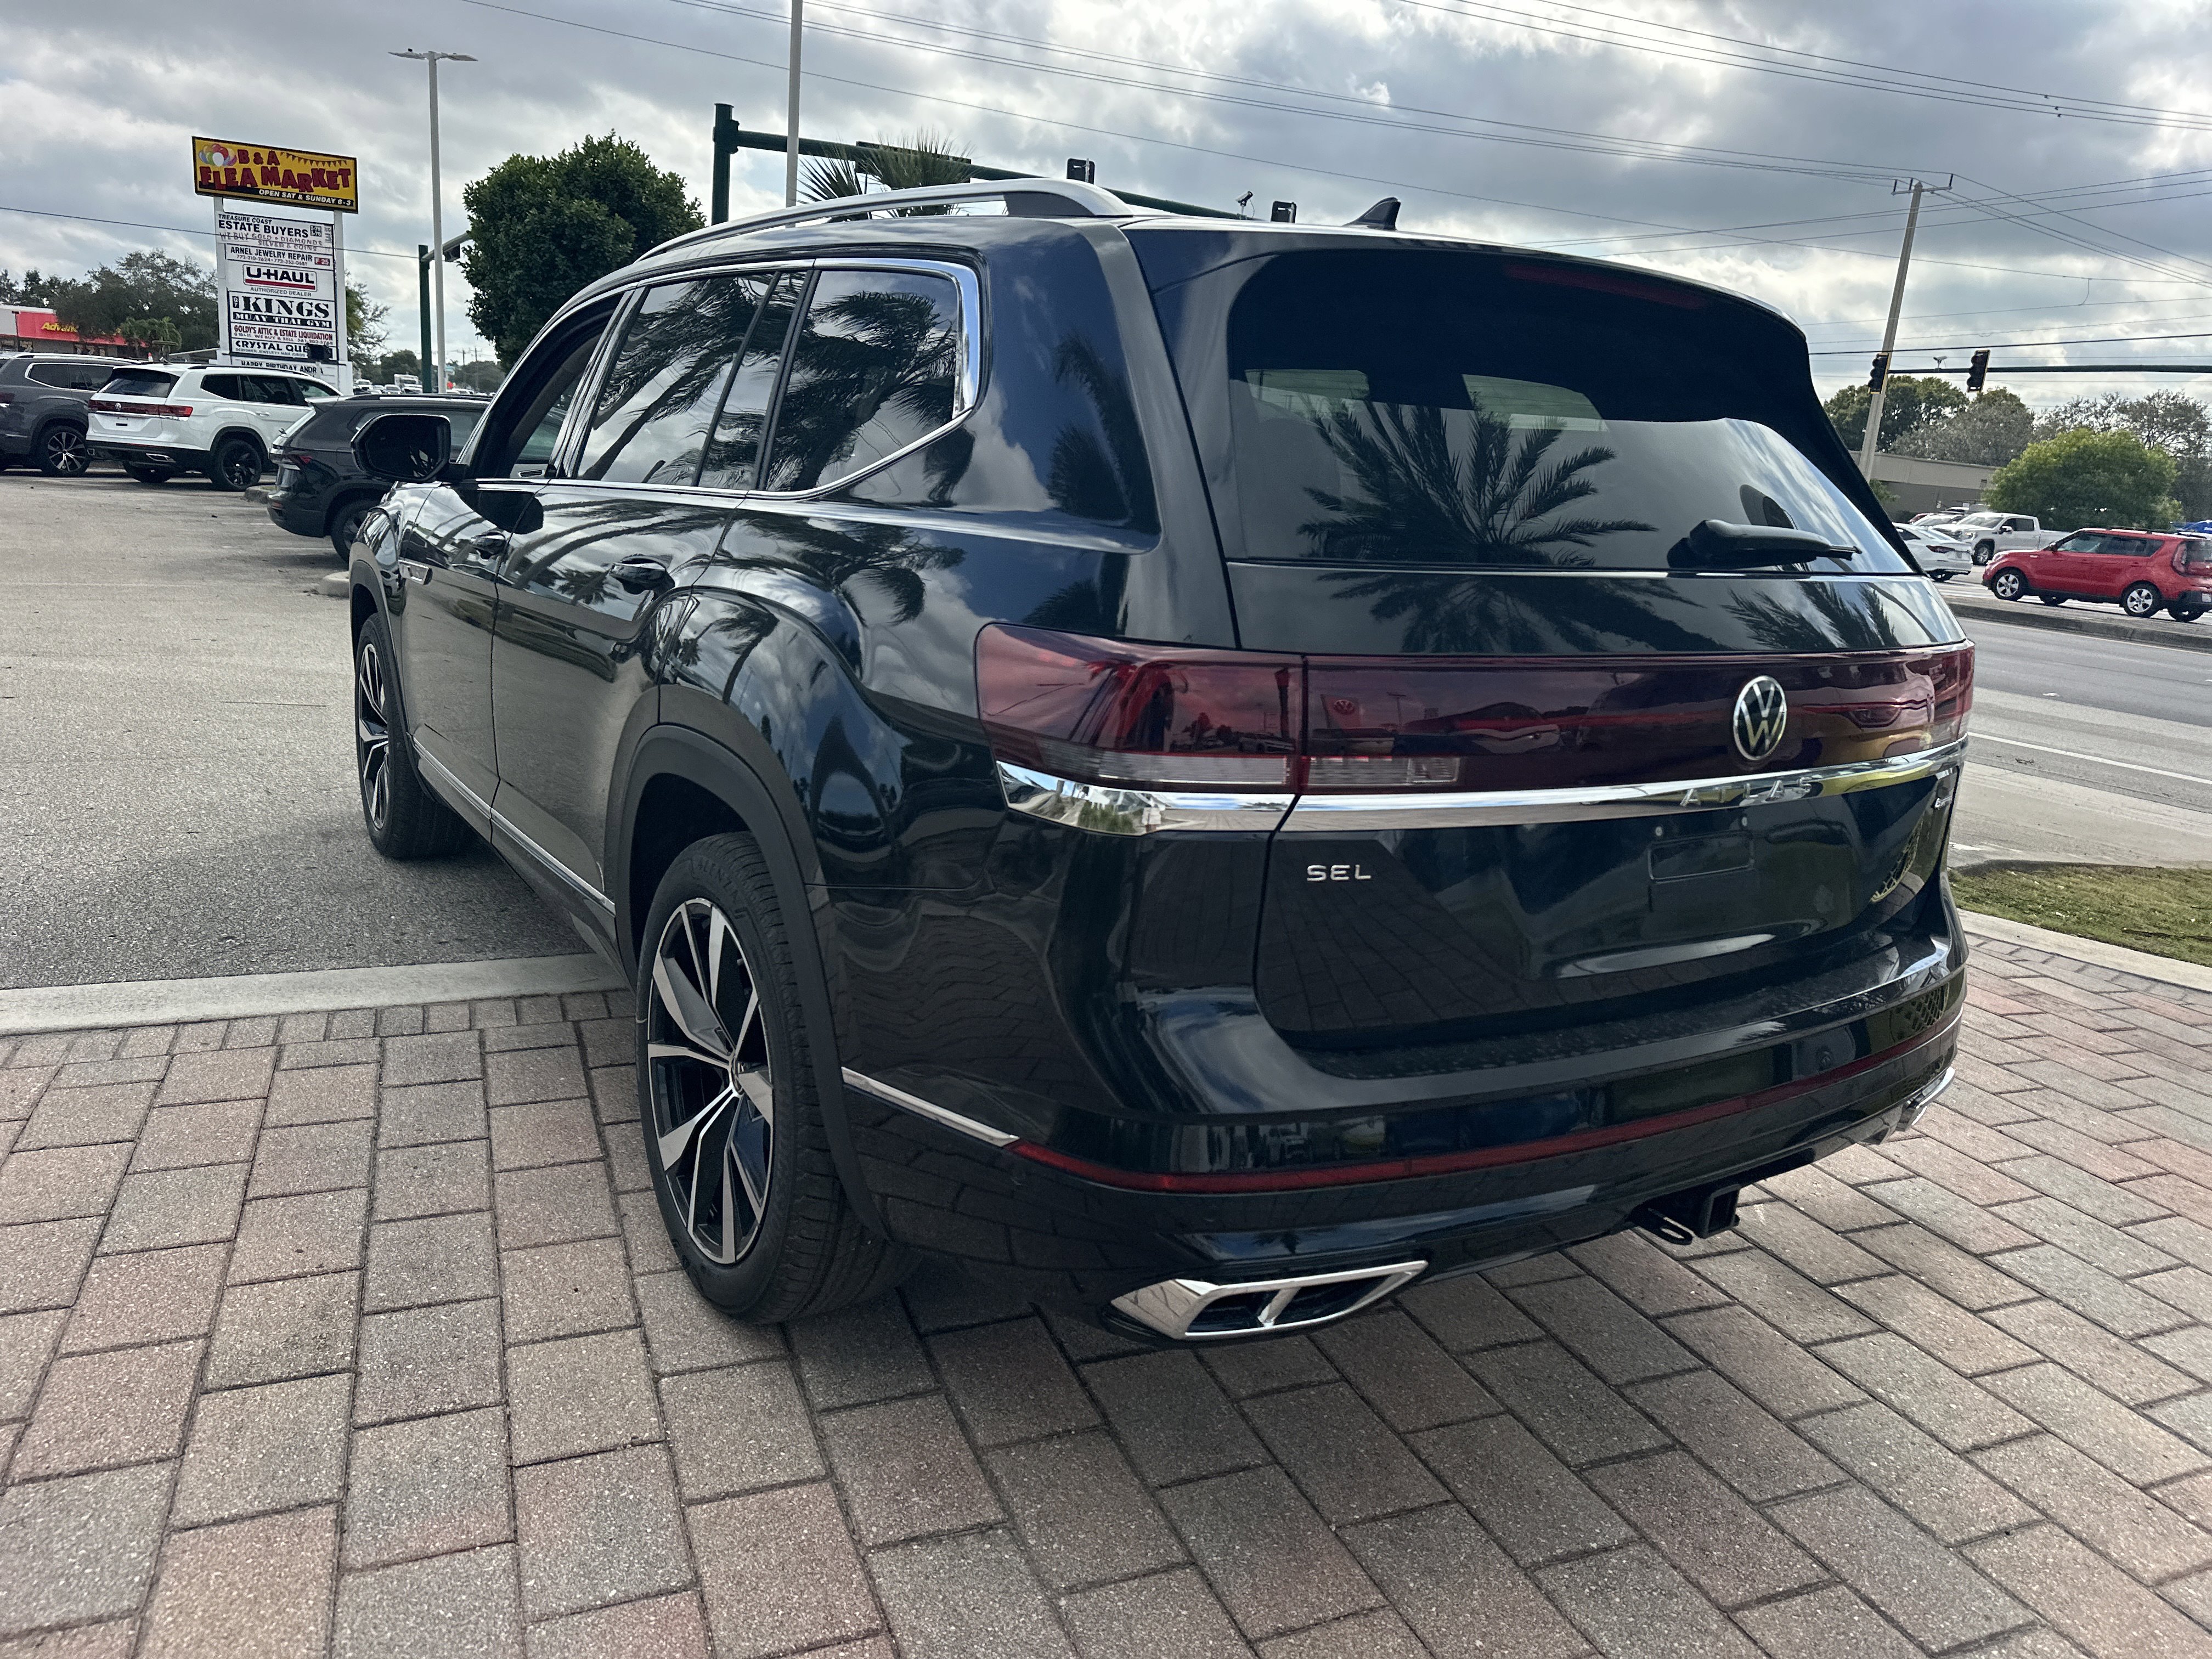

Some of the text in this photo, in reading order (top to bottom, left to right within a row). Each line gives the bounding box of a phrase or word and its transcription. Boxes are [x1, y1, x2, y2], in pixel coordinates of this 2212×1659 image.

[238, 149, 280, 165] B & A
[199, 166, 351, 193] FLEA MARKET
[259, 189, 280, 197] OPEN
[305, 194, 336, 204] SUNDAY
[218, 213, 250, 222] TREASURE
[218, 220, 308, 238] ESTATE BUYERS
[219, 232, 230, 240] WE
[233, 232, 249, 240] BUY
[280, 236, 322, 246] DIAMONDS
[257, 240, 285, 248] SILVER
[230, 246, 313, 262] ARNEL JEWELRY REPAIR
[246, 267, 314, 284] U-HAUL
[250, 286, 287, 295] AUTHORIZED
[241, 296, 329, 318] KINGS
[235, 313, 330, 328] MUAY THAI GYM
[234, 325, 256, 334] GOLDY'S
[280, 329, 297, 338] ESTATE
[298, 331, 333, 341] LIQUIDATION
[235, 340, 283, 351] CRYSTAL
[1680, 776, 1811, 806] ATLAS
[1307, 865, 1372, 882] SEL
